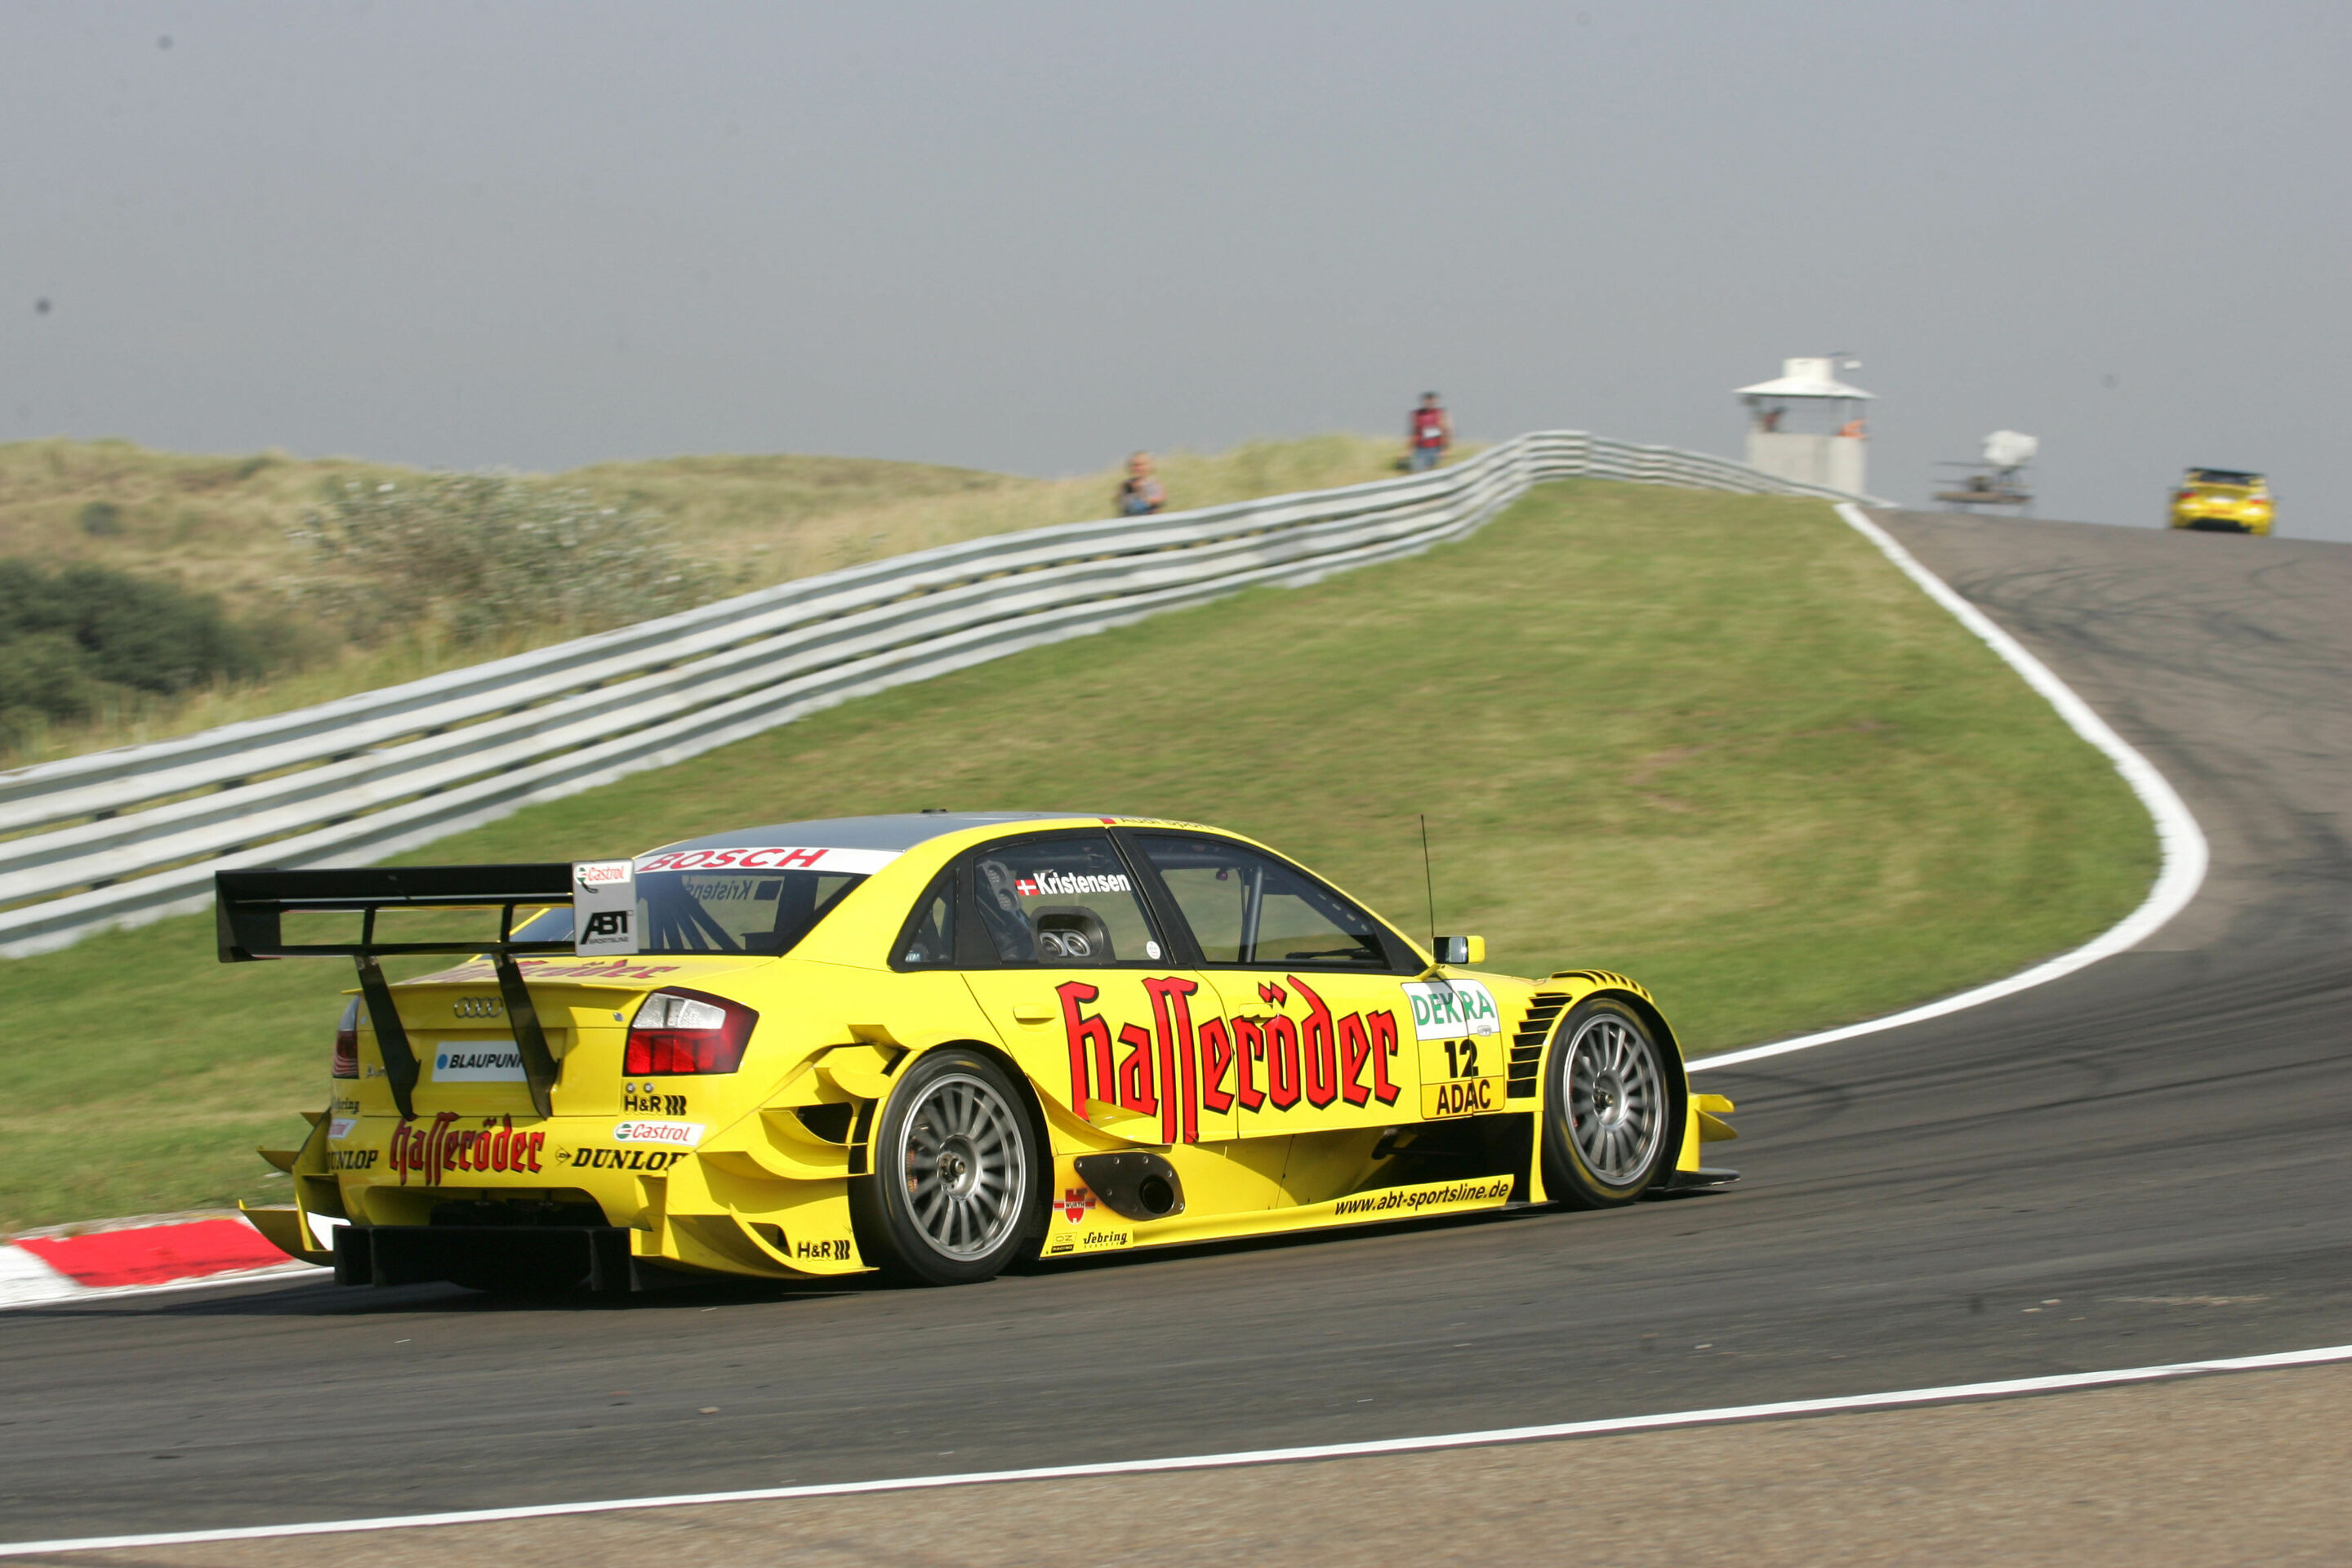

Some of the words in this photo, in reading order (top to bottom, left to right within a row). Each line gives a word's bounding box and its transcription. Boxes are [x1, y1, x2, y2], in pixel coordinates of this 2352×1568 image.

[637, 849, 830, 872] BOSCH
[588, 866, 625, 881] Castrol
[1034, 872, 1132, 895] Kristensen
[580, 911, 628, 945] ABT
[1411, 991, 1495, 1026] DEKRA
[1444, 1039, 1479, 1078] 12
[625, 1095, 661, 1111] H&R
[1437, 1079, 1490, 1115] ADAC
[632, 1124, 690, 1142] Castrol
[327, 1150, 379, 1170] UNLOP
[1335, 1180, 1508, 1215] www.abt-sportsline.de
[798, 1240, 831, 1259] H&R
[1084, 1231, 1128, 1245] Sebring
